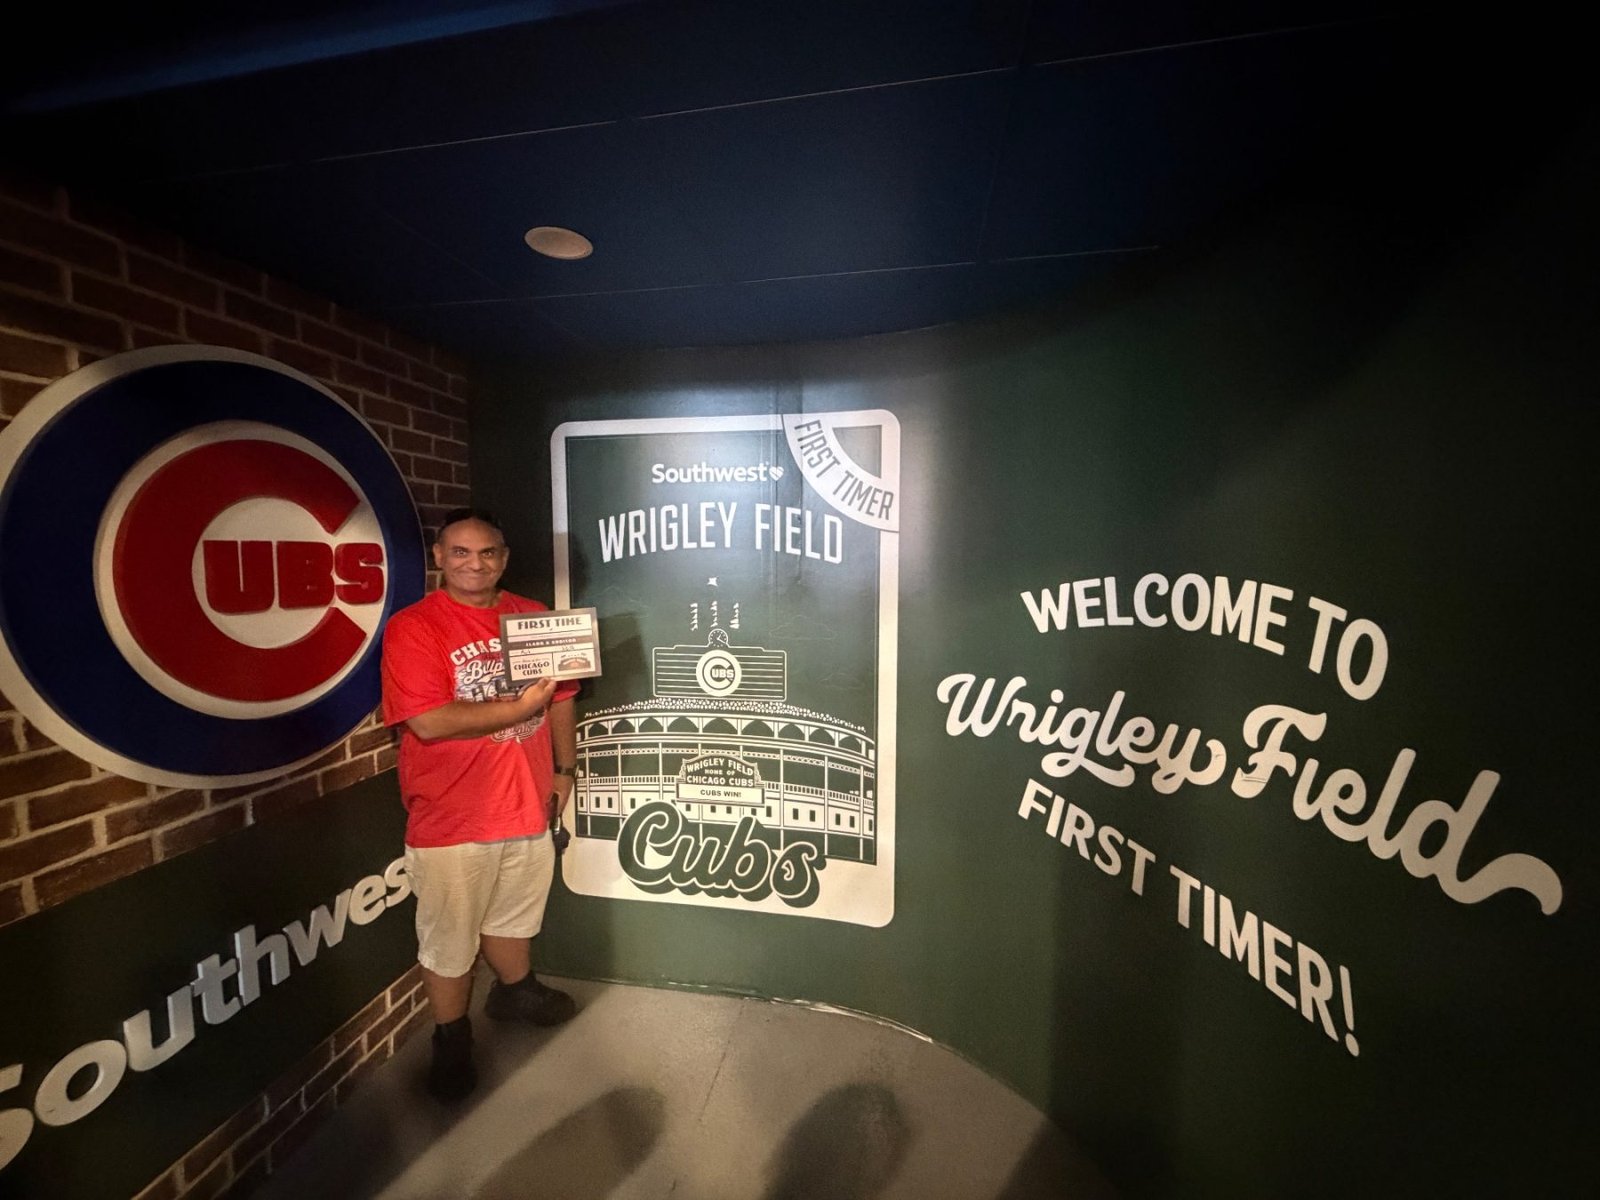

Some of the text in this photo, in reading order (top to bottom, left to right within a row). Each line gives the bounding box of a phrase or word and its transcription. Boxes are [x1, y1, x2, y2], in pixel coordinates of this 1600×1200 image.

[651, 463, 768, 484] Southwest
[794, 419, 895, 521] FIRST TIMER
[112, 439, 385, 704] CUBS
[598, 502, 844, 564] WRIGLEY FIELD
[517, 617, 582, 630] FIRST TIME
[1020, 572, 1389, 701] WELCOME TO
[513, 661, 550, 670] CHICAGO
[522, 668, 543, 676] CUBS
[686, 758, 754, 776] WRIGLEY FIELD
[686, 775, 754, 787] CHICAGO CUBS
[936, 673, 1564, 916] Wrigley Field
[617, 801, 827, 908] Cubs
[1017, 778, 1361, 1058] FIRST TIMER!
[0, 856, 412, 1171] outhwes
